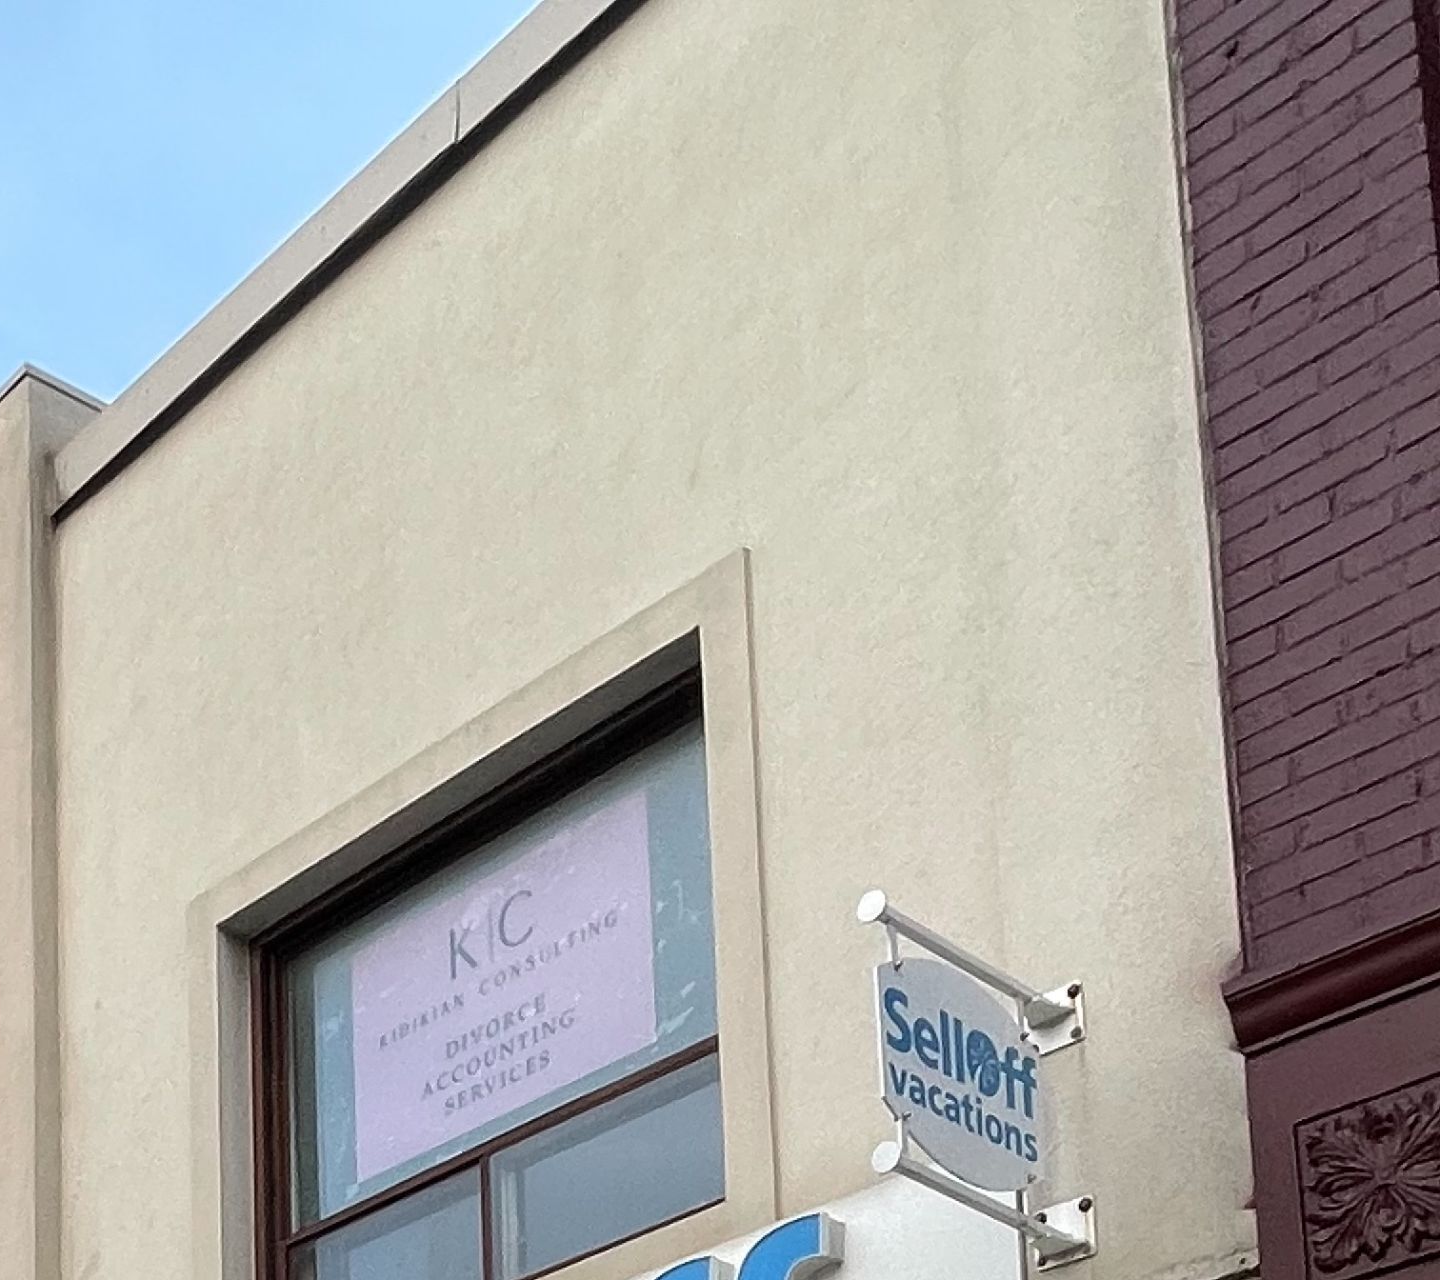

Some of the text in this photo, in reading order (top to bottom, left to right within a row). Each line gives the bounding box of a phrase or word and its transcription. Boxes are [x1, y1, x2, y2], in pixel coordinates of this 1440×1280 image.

[478, 909, 619, 997] CONSULTING
[422, 1007, 577, 1100] ACCOUNTING
[445, 993, 547, 1060] DIVORCE
[883, 987, 1038, 1120] SellOff
[444, 1049, 551, 1116] SERVICES
[887, 1062, 1038, 1163] vacations
